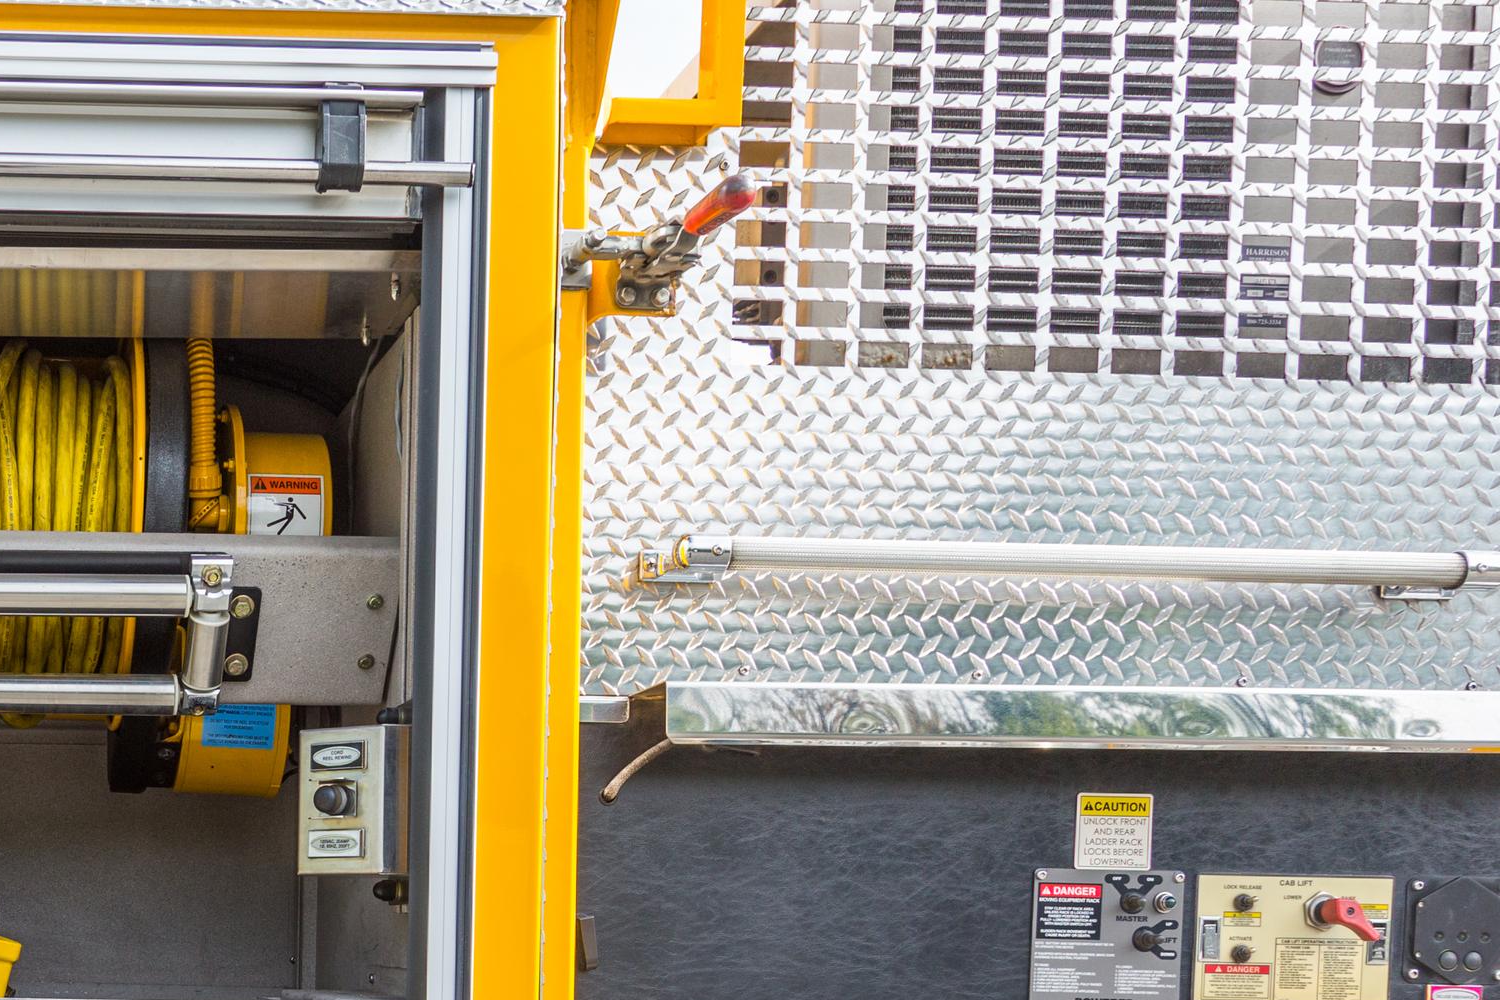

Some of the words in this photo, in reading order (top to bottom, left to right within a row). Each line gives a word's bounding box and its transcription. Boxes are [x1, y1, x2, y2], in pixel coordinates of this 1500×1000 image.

[1246, 248, 1289, 256] HARRISON
[270, 480, 318, 490] WARNING
[1094, 802, 1146, 812] CAUTION
[1053, 887, 1096, 896] DANGER
